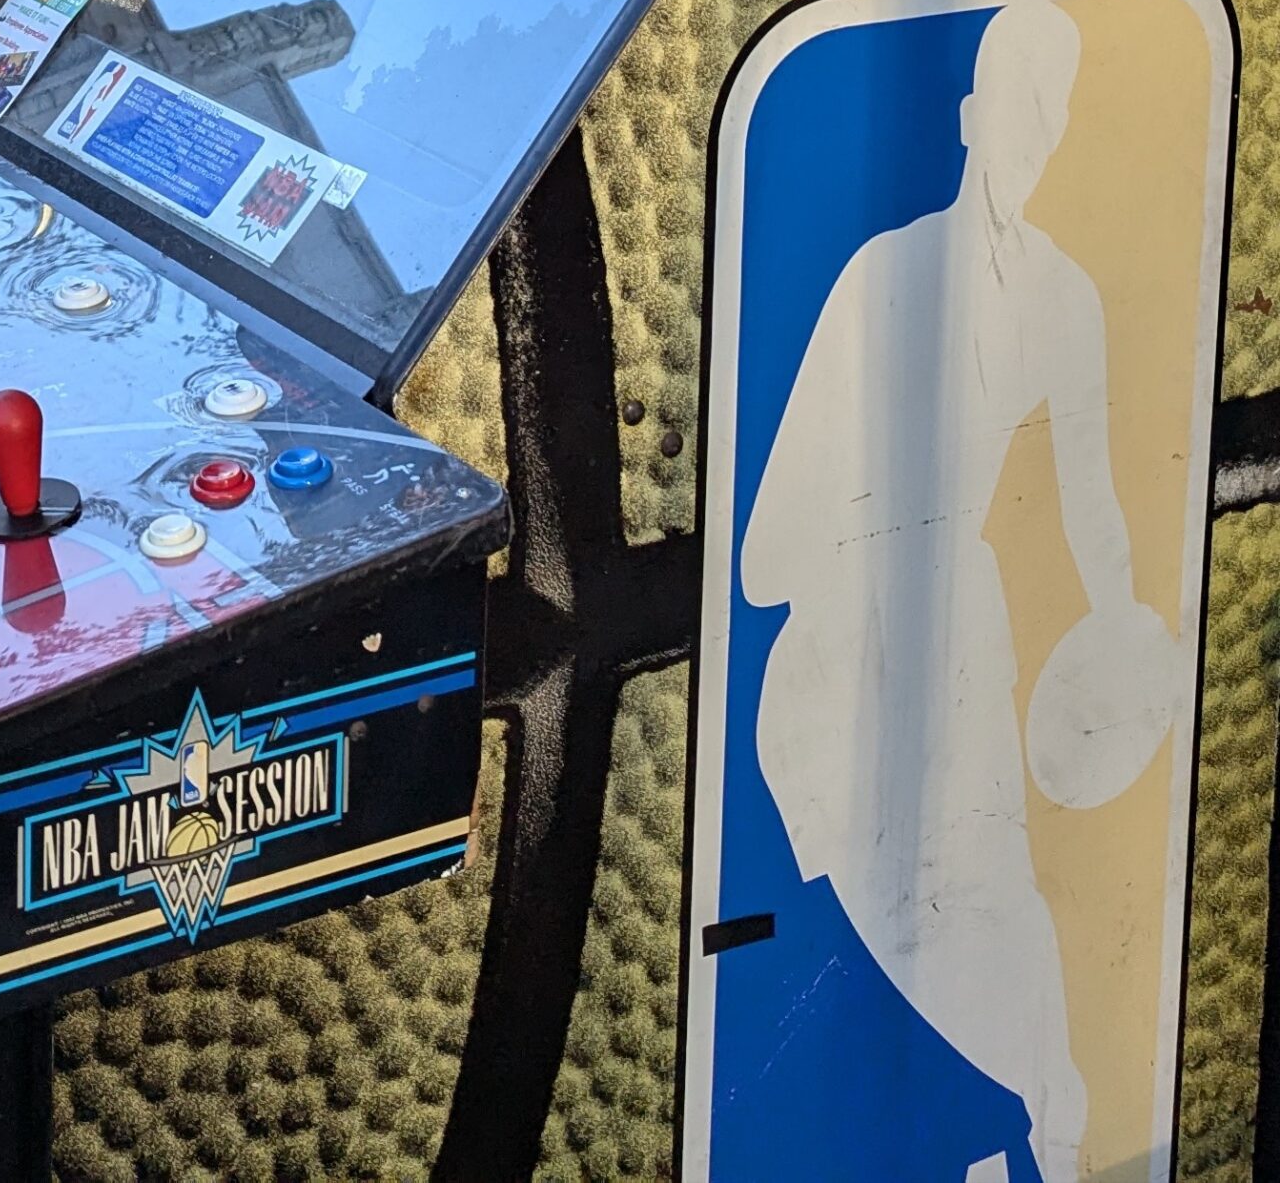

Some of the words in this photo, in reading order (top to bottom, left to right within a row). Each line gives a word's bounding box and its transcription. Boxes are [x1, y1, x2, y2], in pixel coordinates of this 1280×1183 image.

[340, 477, 368, 496] PASS
[42, 813, 101, 892] NBA
[110, 793, 170, 871] JAM
[218, 748, 330, 842] SESSION
